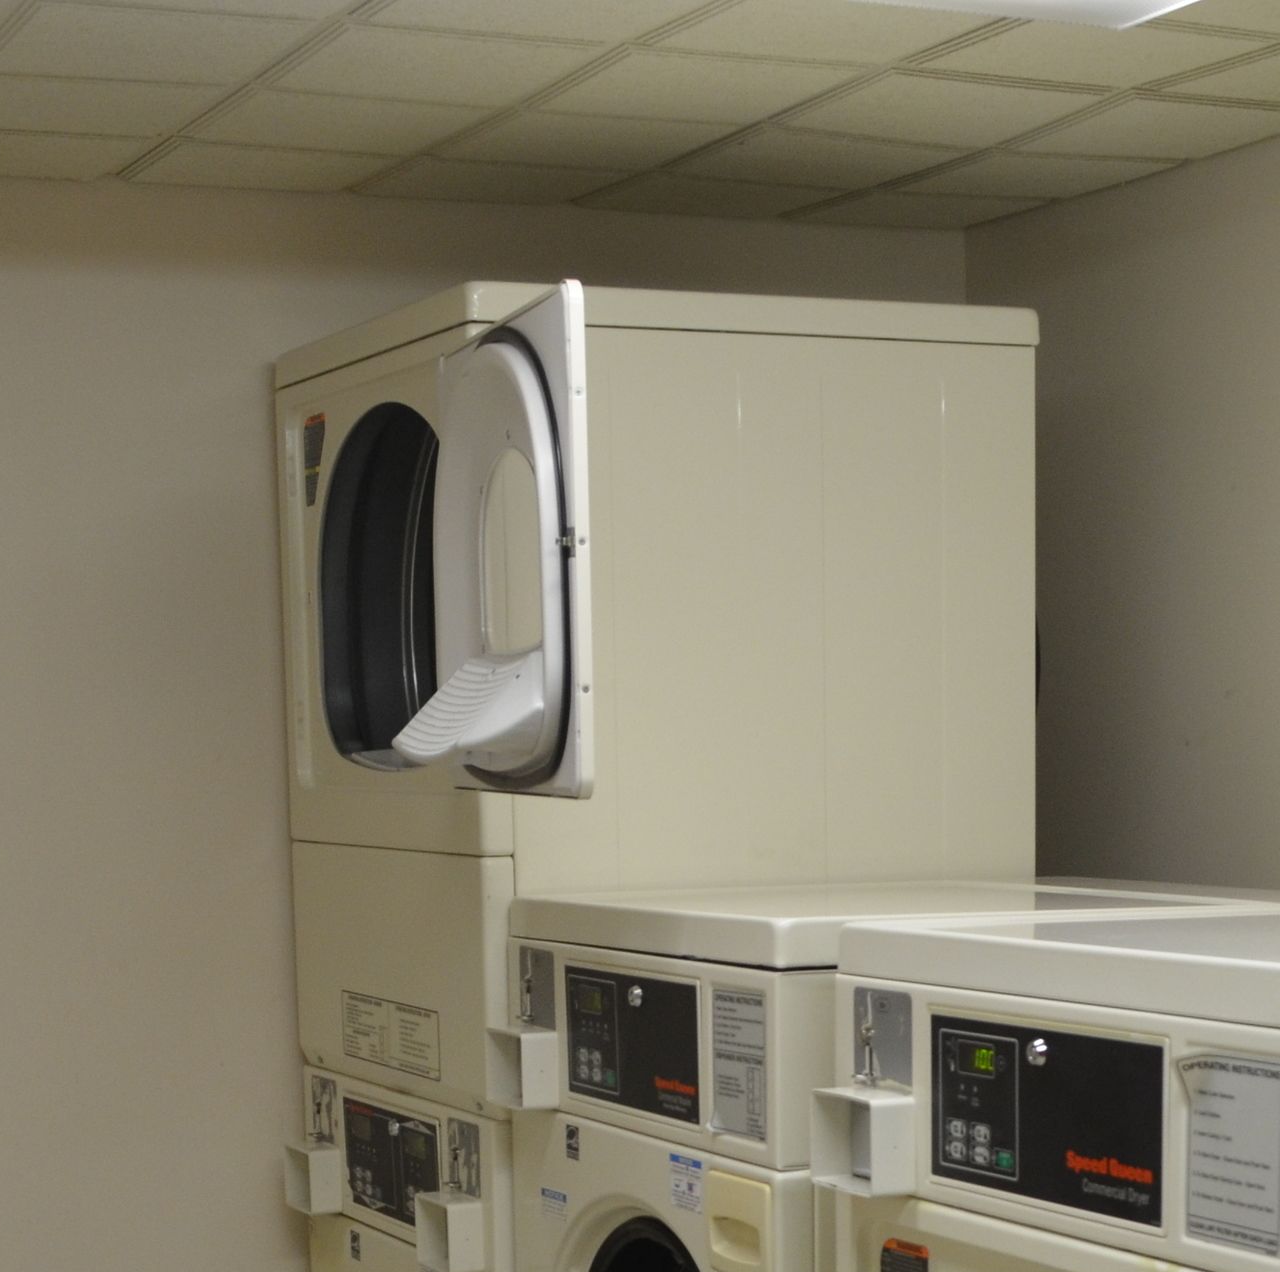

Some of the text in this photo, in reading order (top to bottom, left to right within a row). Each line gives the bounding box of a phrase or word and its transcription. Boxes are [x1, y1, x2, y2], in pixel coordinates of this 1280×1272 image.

[1182, 1060, 1280, 1080] OPERATING INSTRUCTIONS
[1066, 1150, 1153, 1184] Speed Queen
[1082, 1178, 1150, 1207] Commercial Dryer
